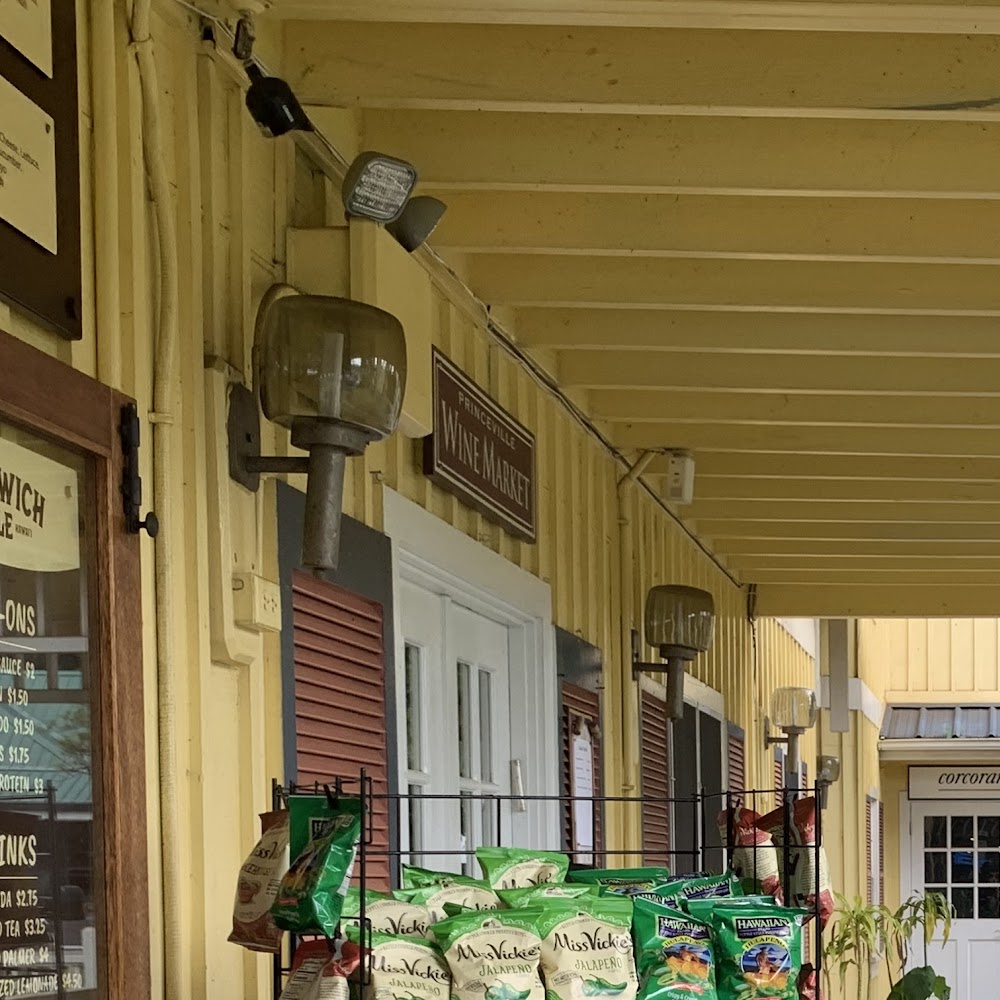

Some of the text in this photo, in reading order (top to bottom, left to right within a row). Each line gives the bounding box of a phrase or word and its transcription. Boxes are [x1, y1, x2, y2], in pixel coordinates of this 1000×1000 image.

[457, 391, 516, 450] PRINCEVILLE
[441, 399, 530, 511] WINE MARKET
[7, 687, 29, 707] $1.50
[14, 718, 35, 736] $1.50
[8, 745, 30, 764] $1.75
[5, 919, 21, 937] TEA
[24, 918, 46, 936] $3.25
[737, 919, 790, 929] HAWAIIAN
[479, 964, 532, 976] JALAPEÑO
[575, 957, 622, 971] JALAPEÑO
